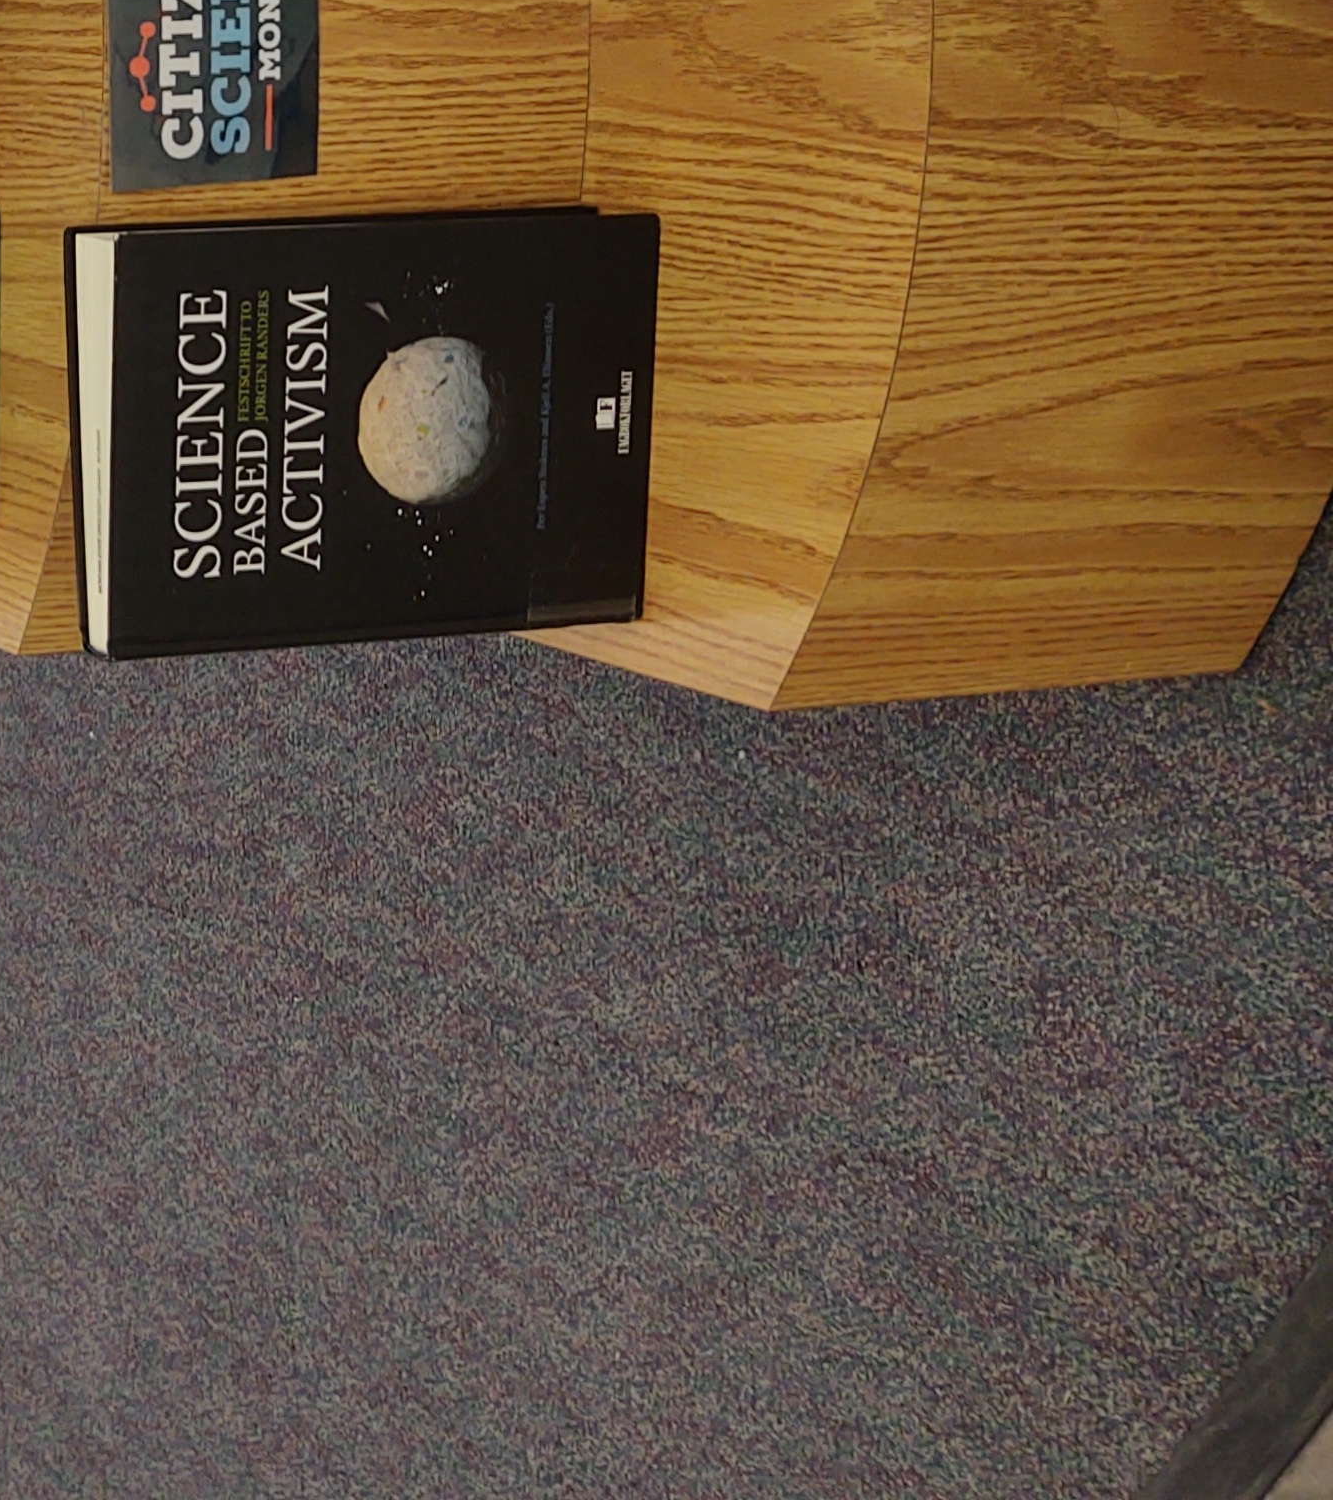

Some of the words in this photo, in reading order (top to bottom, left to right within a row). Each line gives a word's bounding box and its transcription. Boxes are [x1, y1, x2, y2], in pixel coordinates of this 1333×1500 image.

[173, 289, 227, 580] SCIENCE
[233, 428, 269, 575] BASED
[280, 284, 330, 570] ACTIVISM
